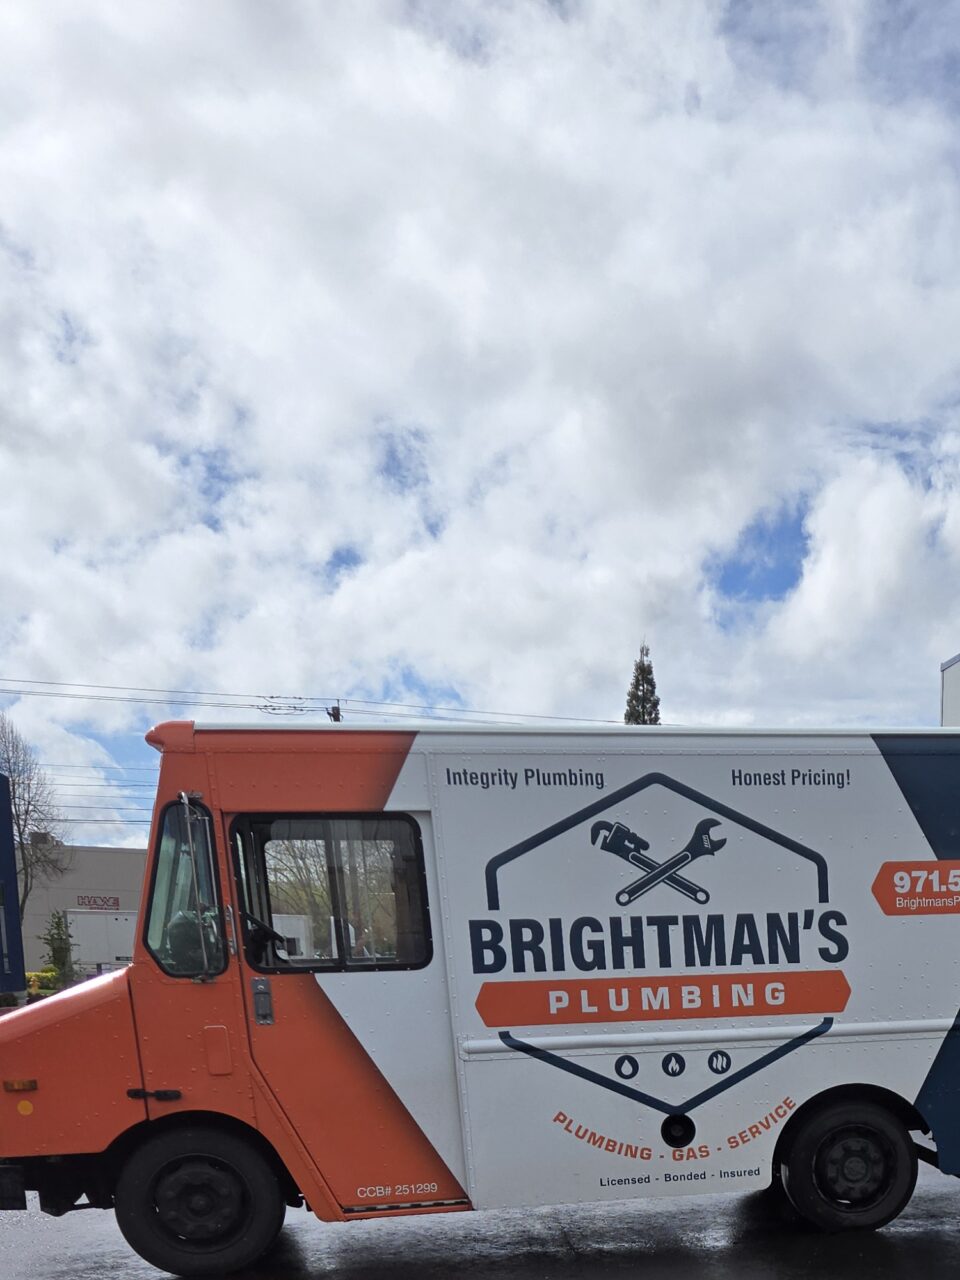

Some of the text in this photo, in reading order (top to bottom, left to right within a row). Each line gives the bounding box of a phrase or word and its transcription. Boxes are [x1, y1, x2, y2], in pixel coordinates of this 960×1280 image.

[446, 768, 604, 790] Integrity Plumbing
[731, 769, 851, 789] Honest Pricing!
[468, 909, 849, 974] BRIGHTMAN'S
[548, 982, 785, 1014] PLUMBING
[552, 1111, 652, 1161] PLUMBING
[672, 1144, 711, 1162] GAS
[726, 1096, 797, 1150] SERVICE
[600, 1174, 651, 1187] Licensed
[664, 1171, 707, 1183] Bonded
[719, 1167, 761, 1179] Insured
[357, 1182, 438, 1198] CCB# 251299
